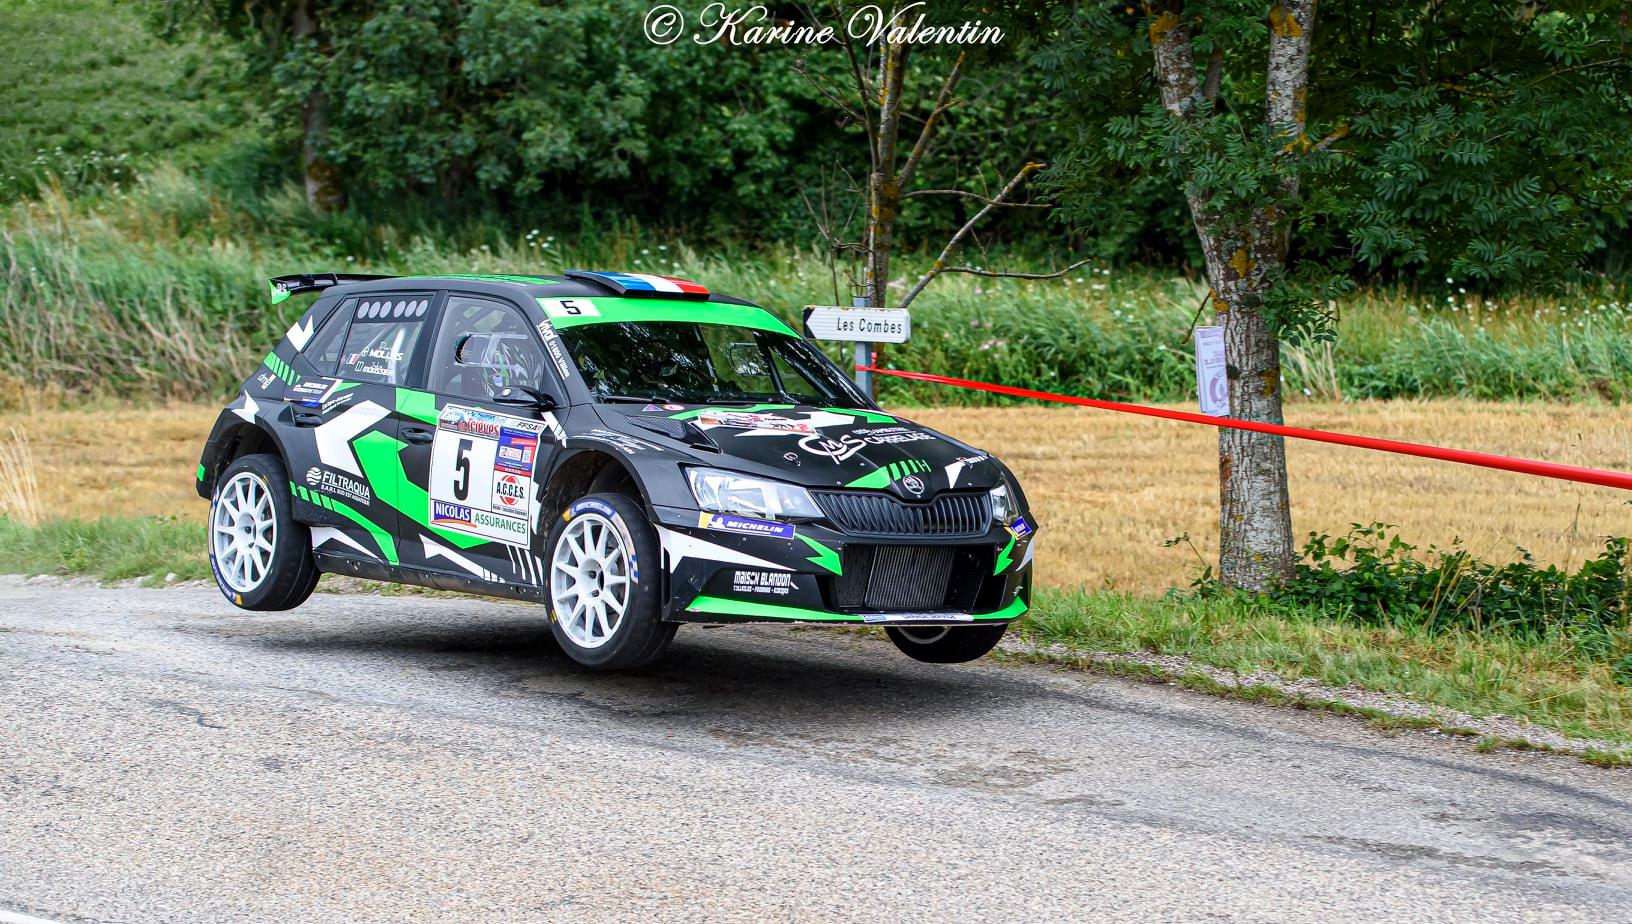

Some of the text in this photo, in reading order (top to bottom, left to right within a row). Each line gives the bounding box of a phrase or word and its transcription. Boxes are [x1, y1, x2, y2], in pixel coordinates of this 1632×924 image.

[560, 300, 582, 315] 5
[837, 317, 903, 335] Les Combes
[453, 438, 474, 502] 5
[322, 470, 370, 500] FILTRAQUA
[435, 502, 471, 521] NICOLAS
[474, 513, 527, 535] ASSURANCES
[726, 520, 785, 534] MICHELIN
[760, 572, 792, 588] BLANDON
